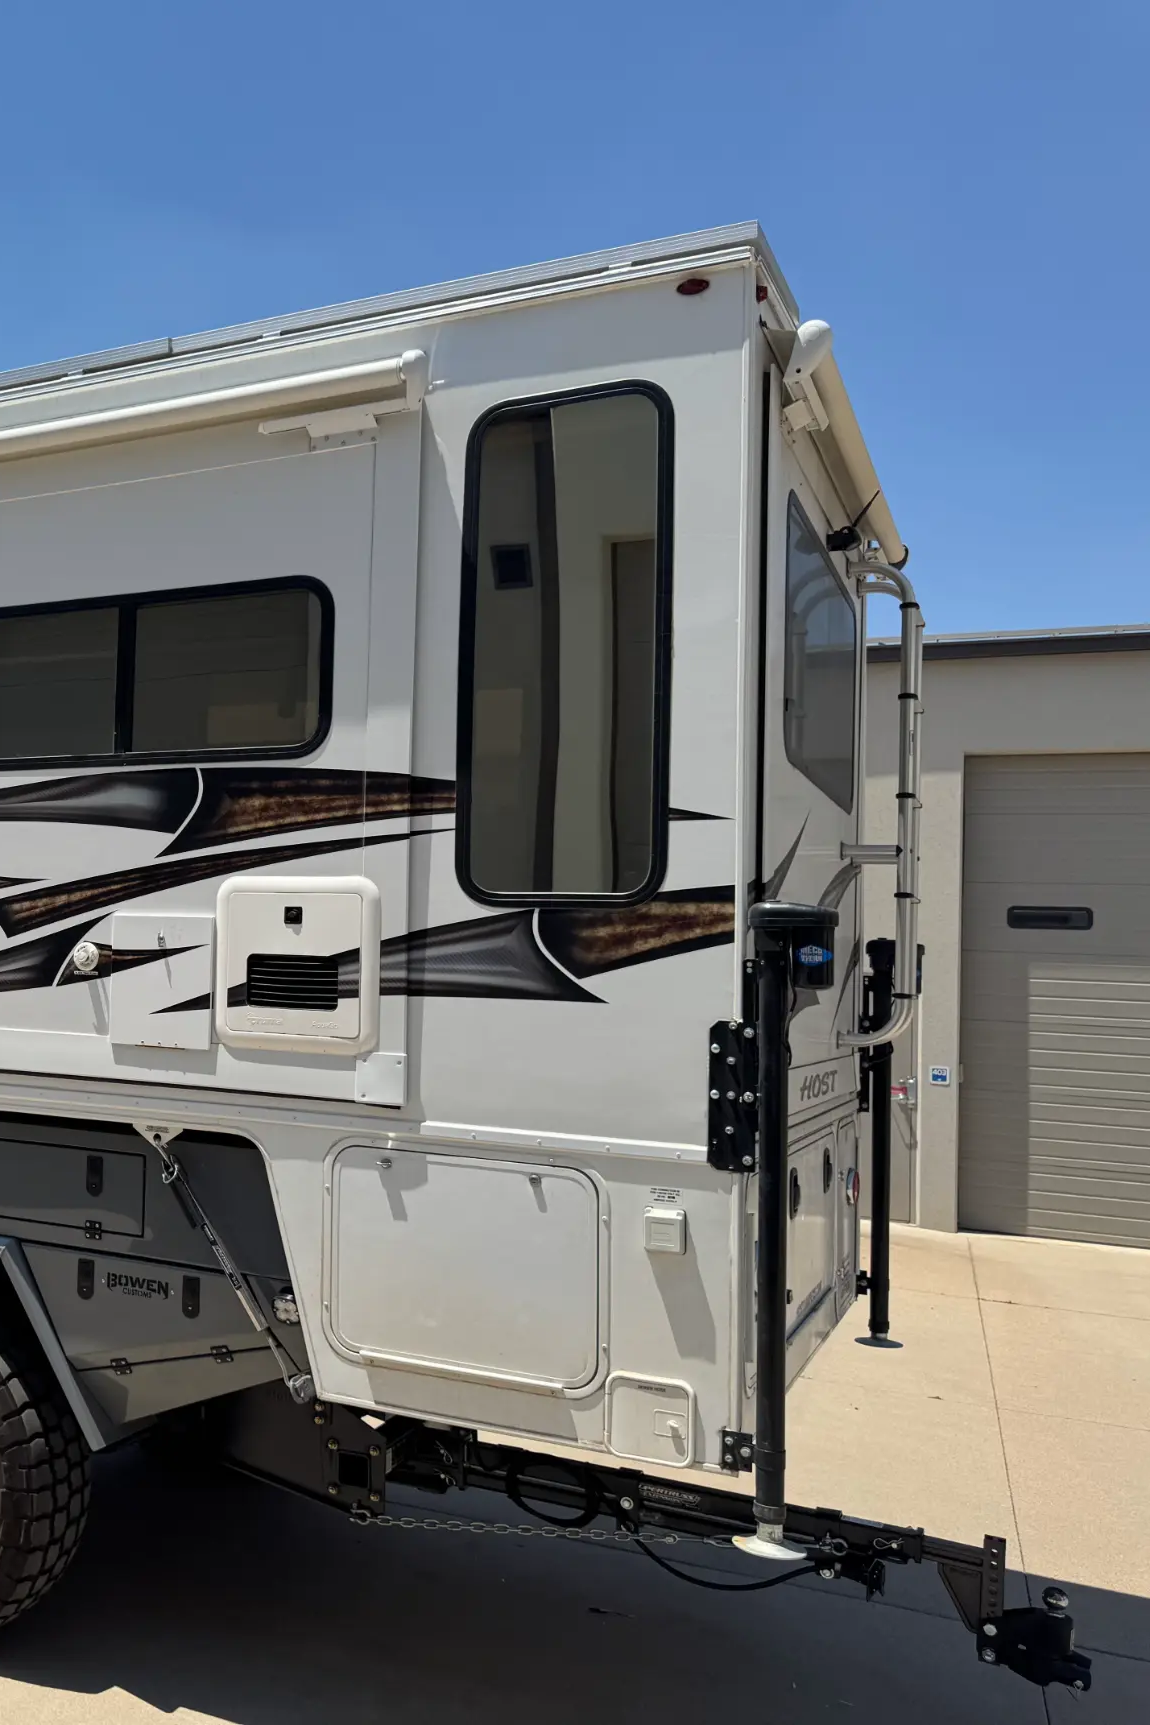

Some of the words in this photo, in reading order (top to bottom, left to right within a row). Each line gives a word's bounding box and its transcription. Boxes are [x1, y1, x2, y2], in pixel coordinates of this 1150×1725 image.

[800, 1069, 838, 1102] HOST
[107, 1271, 169, 1300] BOWEN
[122, 1287, 152, 1299] CUSTOMS
